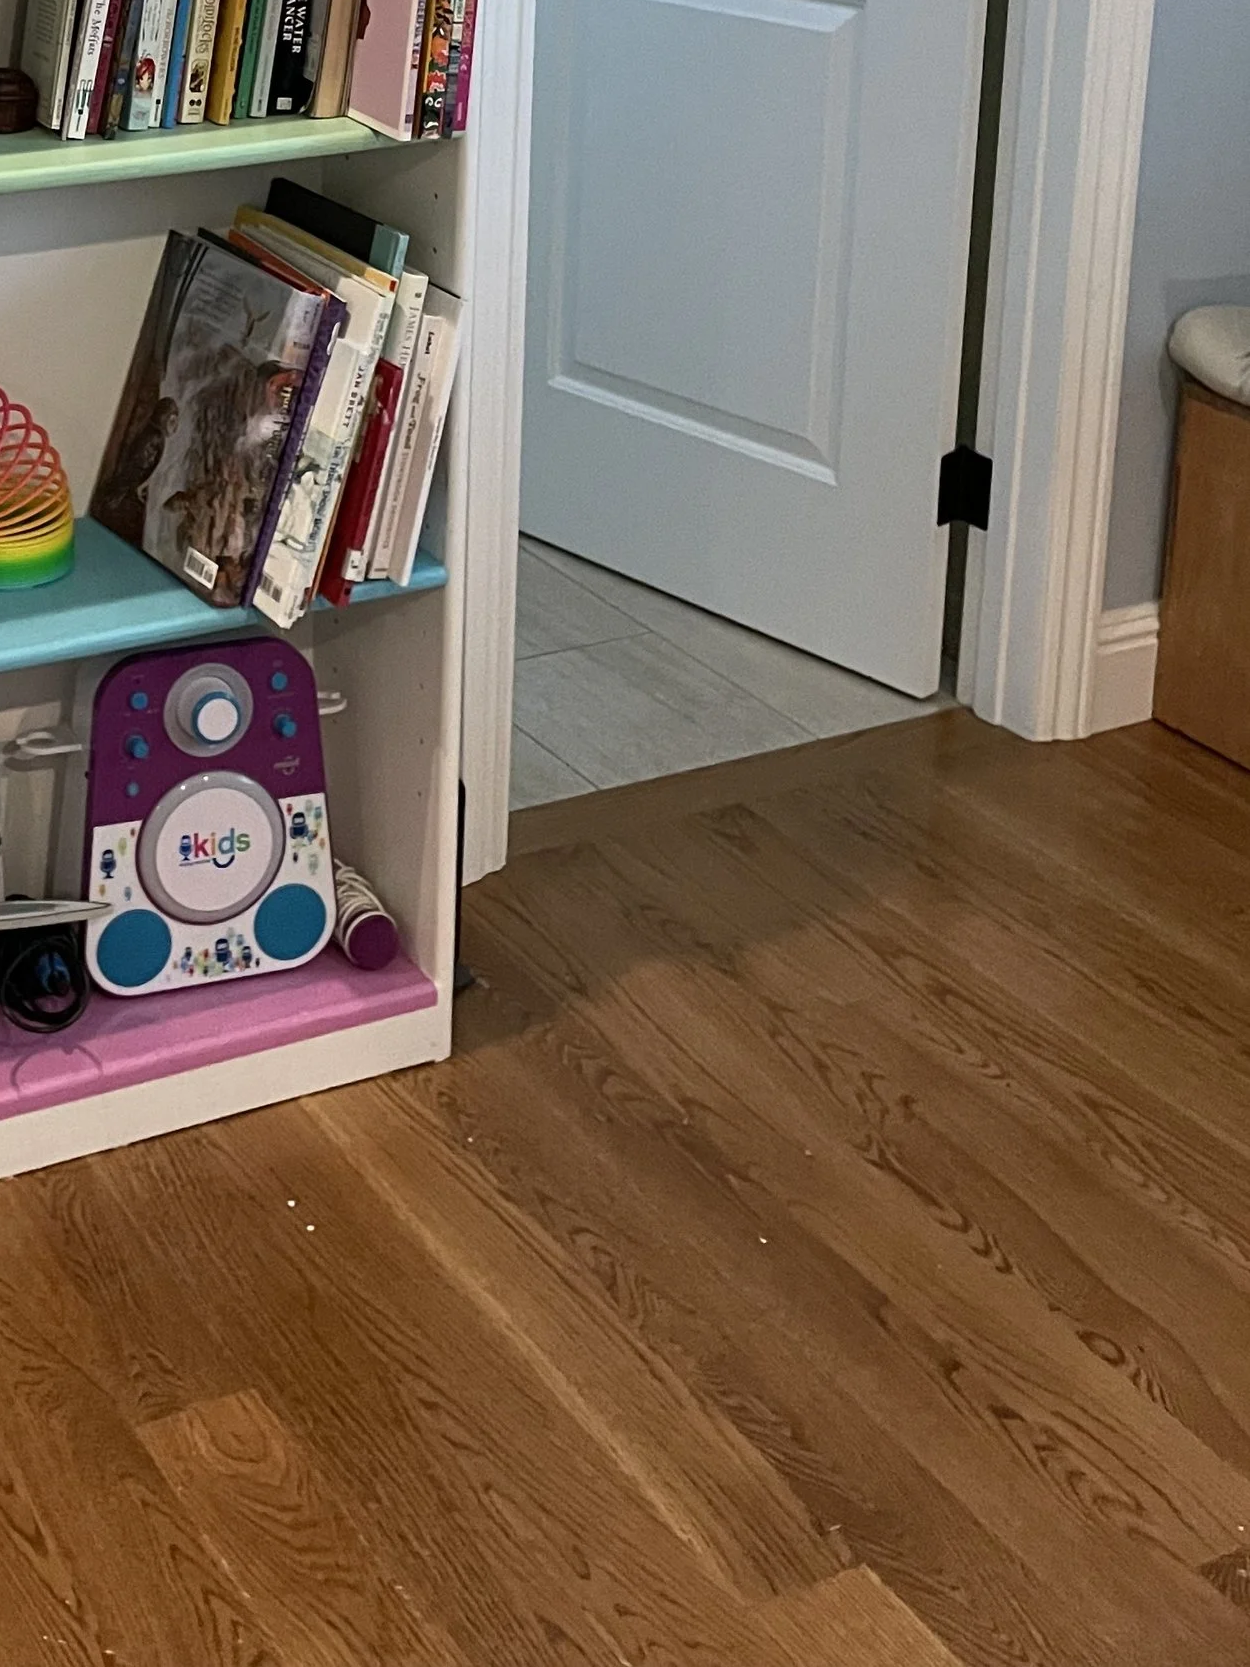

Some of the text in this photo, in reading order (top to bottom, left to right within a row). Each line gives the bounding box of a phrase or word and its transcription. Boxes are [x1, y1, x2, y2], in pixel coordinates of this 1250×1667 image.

[87, 19, 102, 56] Moffats
[291, 6, 307, 54] WATER
[159, 21, 173, 80] BORROWERS
[400, 306, 420, 344] JAMES
[355, 365, 364, 391] JAN
[409, 372, 427, 405] Frog
[342, 394, 357, 428] BRETT
[402, 419, 420, 449] Toad
[193, 828, 250, 858] kids
